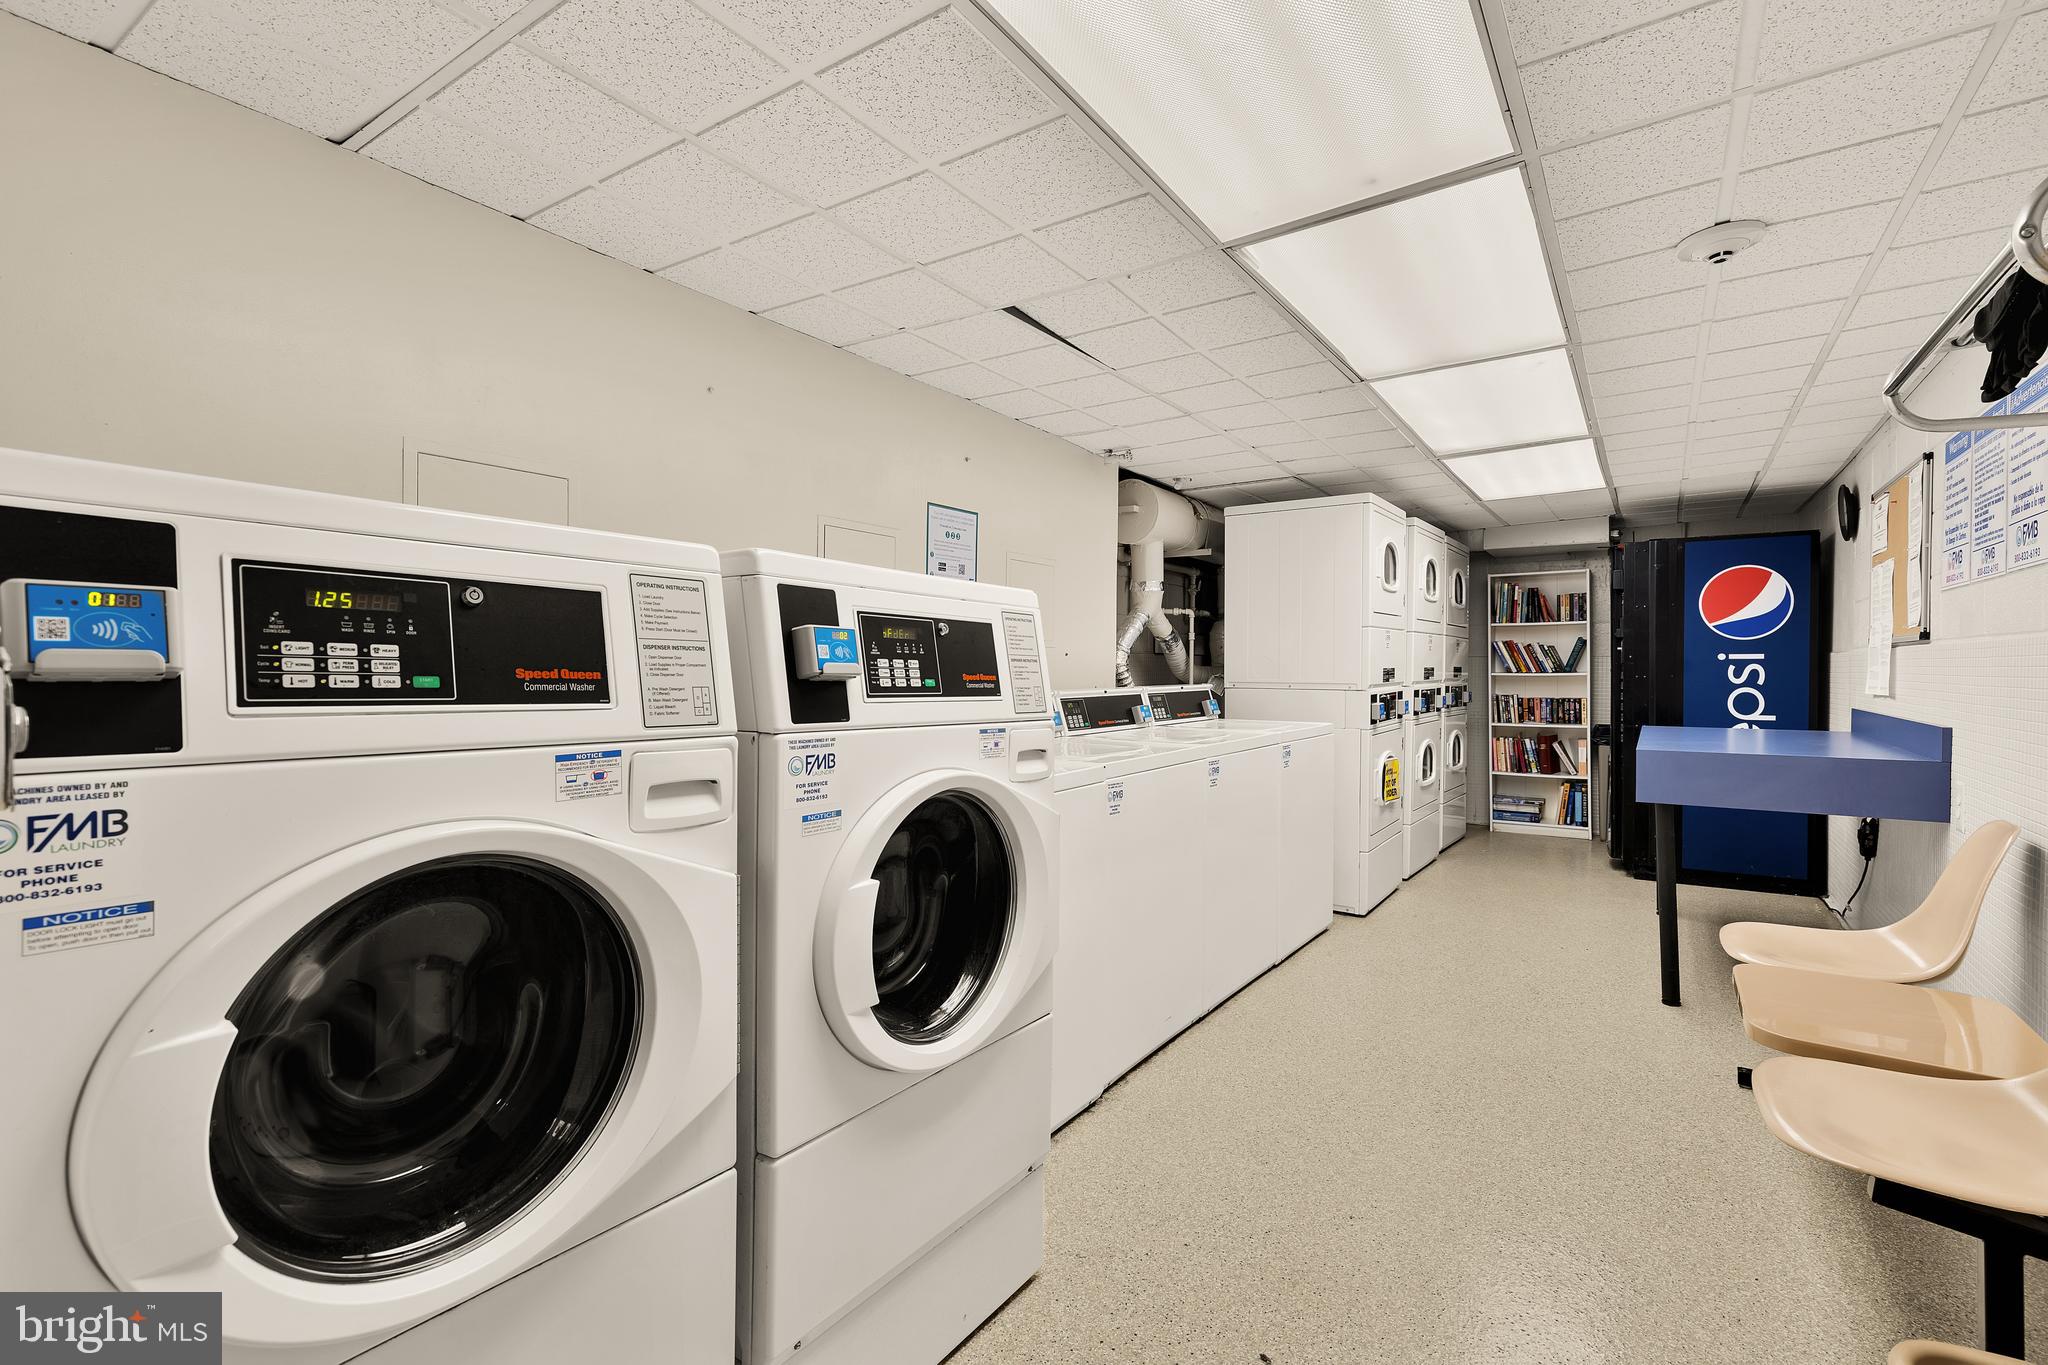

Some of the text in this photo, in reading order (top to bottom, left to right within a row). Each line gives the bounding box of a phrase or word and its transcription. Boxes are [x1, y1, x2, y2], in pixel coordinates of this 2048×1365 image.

[2022, 520, 2039, 546] FMB
[314, 591, 352, 609] 1.25
[515, 668, 602, 681] Speed Queen
[524, 682, 596, 691] Commercial Washer
[1717, 653, 1776, 729] psi
[806, 753, 836, 776] FMB
[13, 786, 54, 795] CHINES
[57, 784, 91, 792] OWNED
[15, 797, 42, 805] NDRY
[46, 795, 71, 803] AREA
[74, 792, 110, 801] LEASED
[807, 812, 836, 820] NOTICE
[26, 809, 129, 853] FMB
[51, 837, 127, 854] LAUNDRY
[34, 859, 104, 874] SERVICE
[21, 874, 78, 888] PHONE
[42, 904, 138, 926] NOTICE
[26, 930, 53, 938] DOOR
[80, 922, 104, 930] LIGHT
[54, 931, 92, 941] attempting
